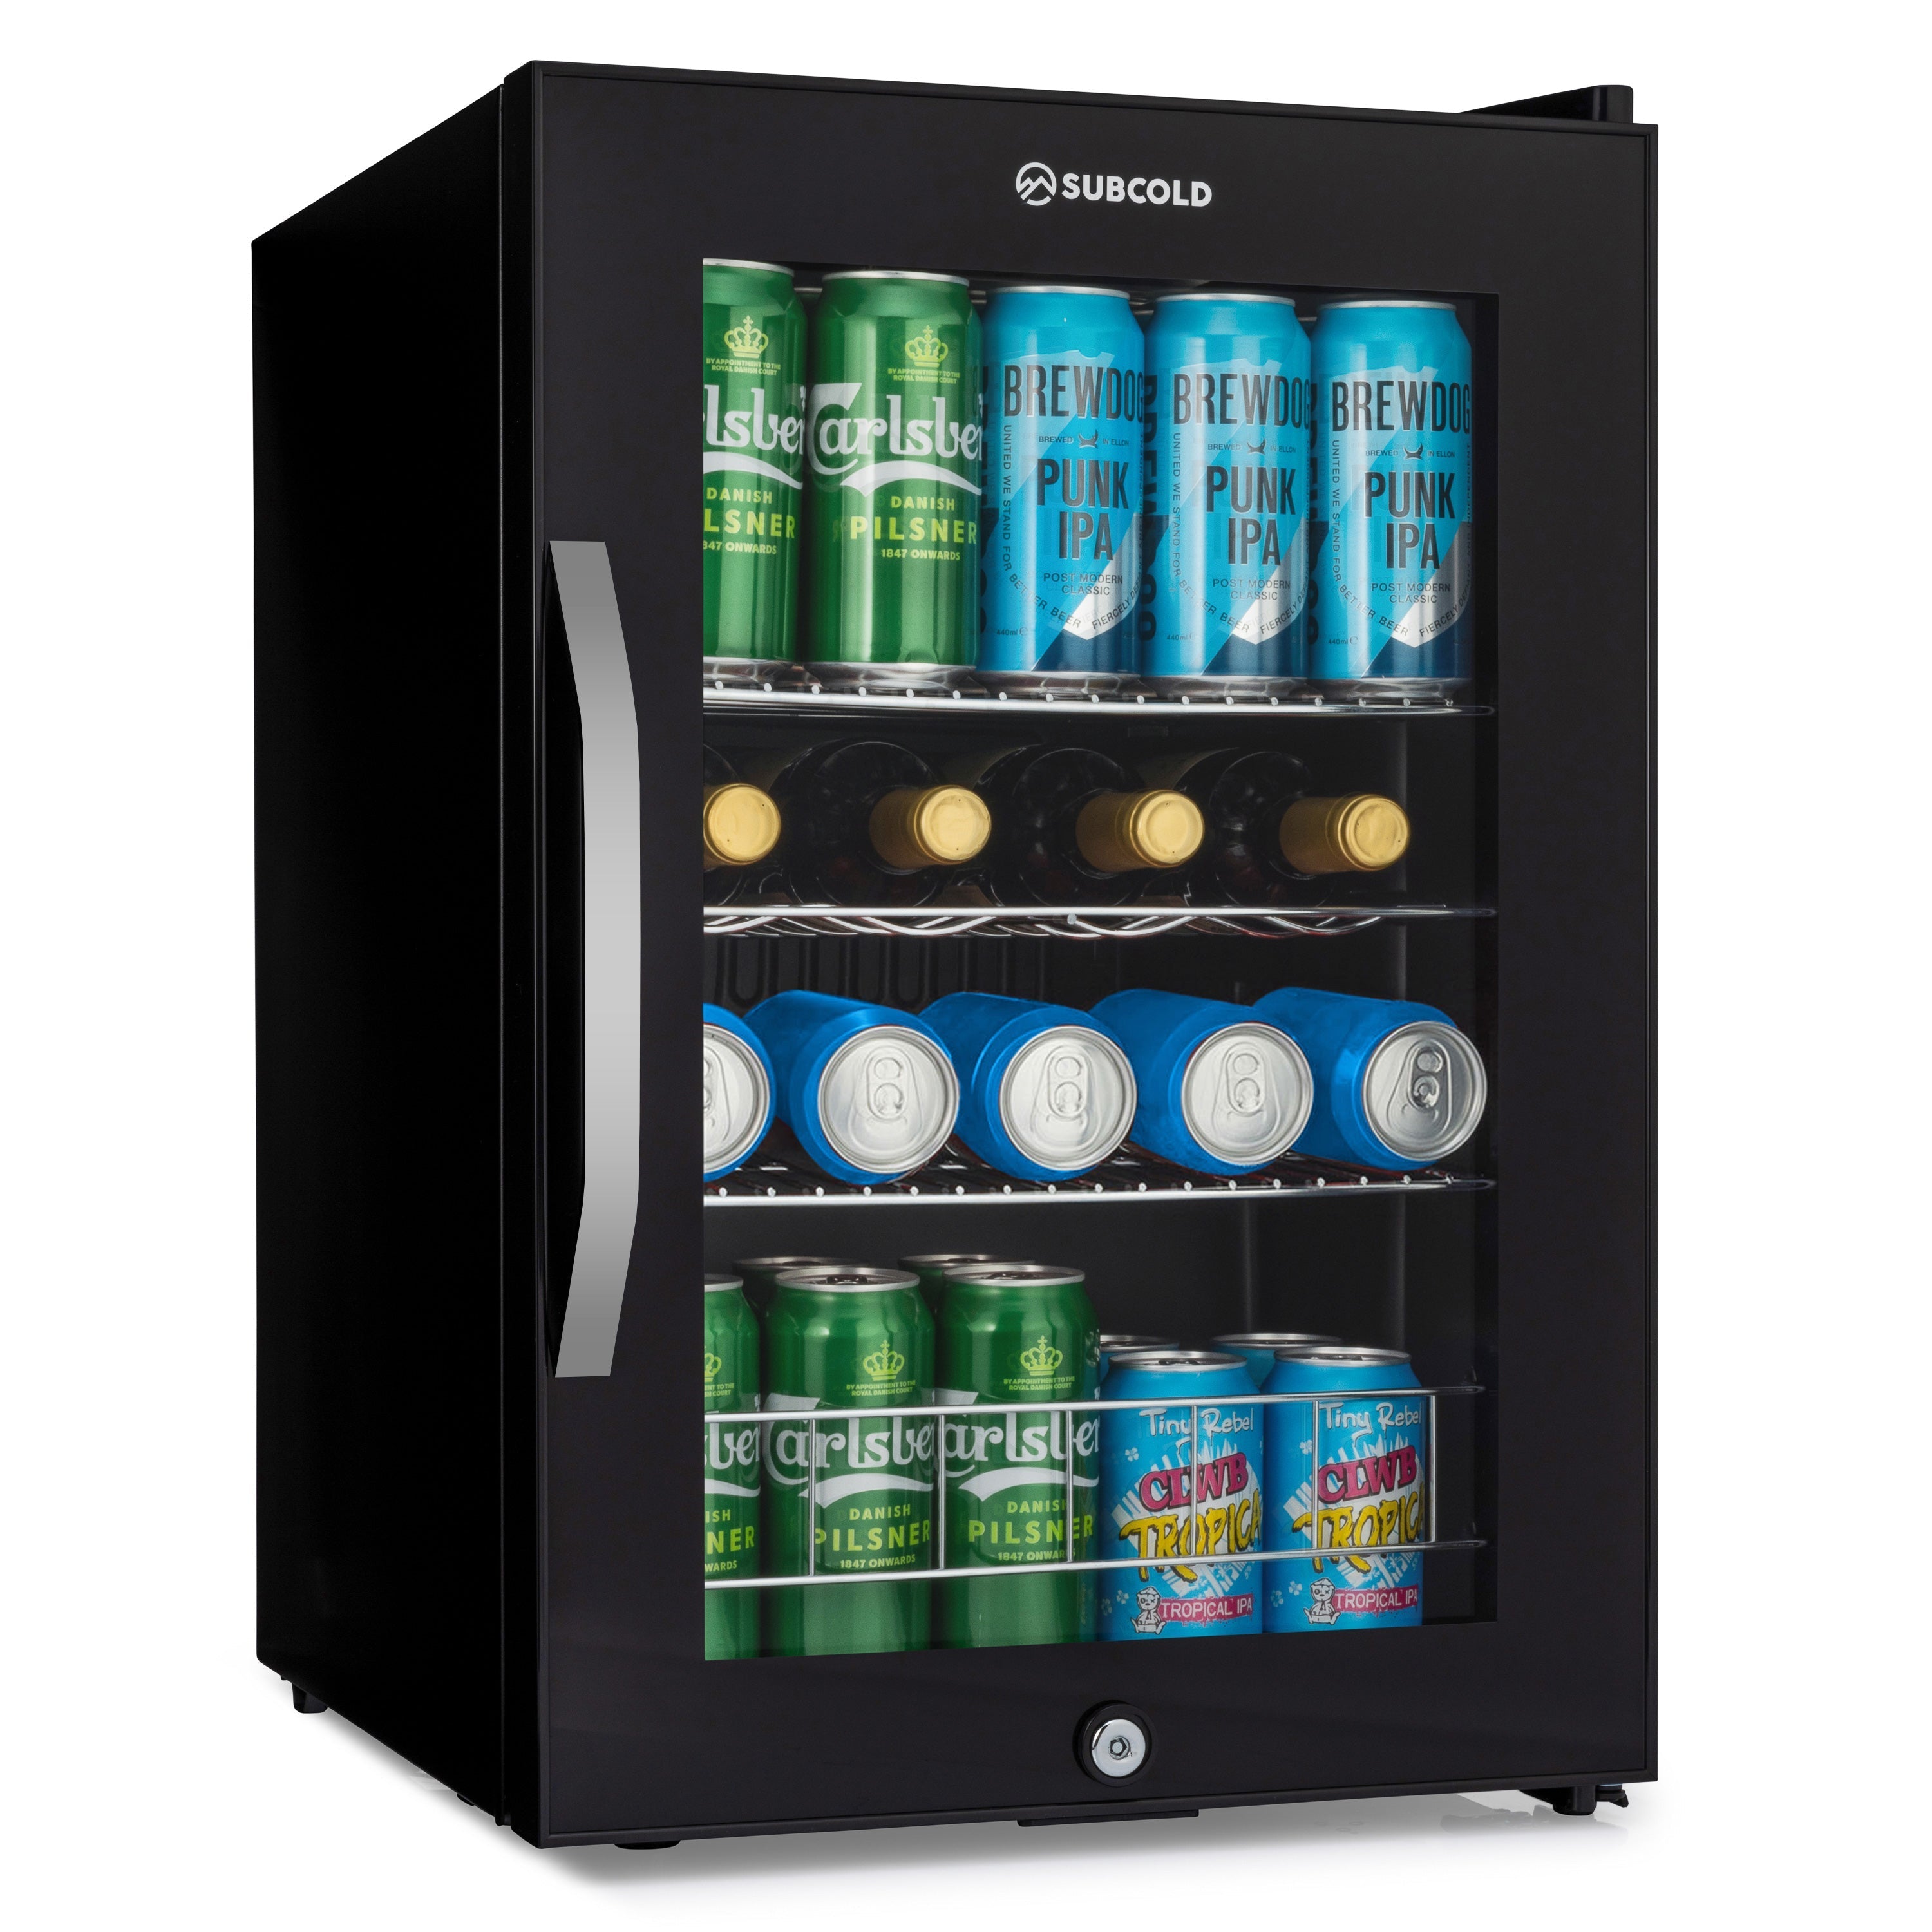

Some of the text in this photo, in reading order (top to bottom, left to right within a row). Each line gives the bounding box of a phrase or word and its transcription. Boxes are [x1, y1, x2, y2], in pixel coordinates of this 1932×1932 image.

[1061, 173, 1212, 207] SUBCOLD
[715, 359, 762, 368] APPOINTMENT
[1004, 365, 1144, 423] BREWDOG
[1173, 373, 1310, 430] BREWDOG
[1332, 380, 1470, 435] BREWDOG
[1003, 425, 1012, 469] UNITED
[1173, 433, 1181, 477] UNITED
[1332, 440, 1340, 483] UNITED
[706, 487, 772, 504] DANISH
[1003, 477, 1012, 494] WE
[1037, 458, 1130, 509] PUNK
[1173, 484, 1180, 501] WE
[1206, 466, 1296, 515] PUNK
[1364, 471, 1455, 518] PUNK
[891, 495, 955, 511] DANISH
[1332, 489, 1340, 507] WE
[850, 516, 977, 544] PILSNER
[1003, 500, 1011, 540] STAND
[1172, 507, 1180, 546] STAND
[1332, 513, 1340, 552] STAND
[725, 541, 777, 554] ONWARDS
[1059, 511, 1113, 561] IPA
[1227, 517, 1281, 565] IPA
[1386, 522, 1440, 569] IPA
[881, 549, 960, 560] 1847 ONWARDS
[1003, 545, 1012, 571] FOR
[1172, 553, 1181, 577] FOR
[1043, 573, 1123, 585] POST MODERN
[1213, 578, 1291, 589] POST MODERN
[1332, 558, 1341, 582] FOR
[1061, 585, 1110, 596] CLASSIC
[1230, 591, 1278, 600] CLASSIC
[1339, 584, 1376, 619] BETTER
[1371, 583, 1450, 592] POST MODERN
[1389, 594, 1437, 603] CLASSIC
[1050, 607, 1081, 629] BEER
[1092, 597, 1130, 630] FIERCELY
[1220, 612, 1249, 632] BEER
[1260, 602, 1298, 634] FIERCELY
[1379, 616, 1408, 636] BEER
[1419, 604, 1459, 637] FIERCELY
[1200, 1407, 1253, 1440] Rebel
[1318, 1401, 1421, 1447] Tiny Rebel
[761, 1392, 934, 1486] Carlsbe
[1139, 1452, 1249, 1512] CLWB
[1318, 1444, 1417, 1504] CLWB
[849, 1504, 911, 1520] DANISH
[706, 1526, 755, 1555] NER
[998, 1548, 1076, 1561] 1847 ONWAR
[840, 1554, 916, 1569] 1847 ONWARDS
[1160, 1598, 1253, 1618] TROPICAL IPA
[1334, 1593, 1402, 1609] TROPICAL
